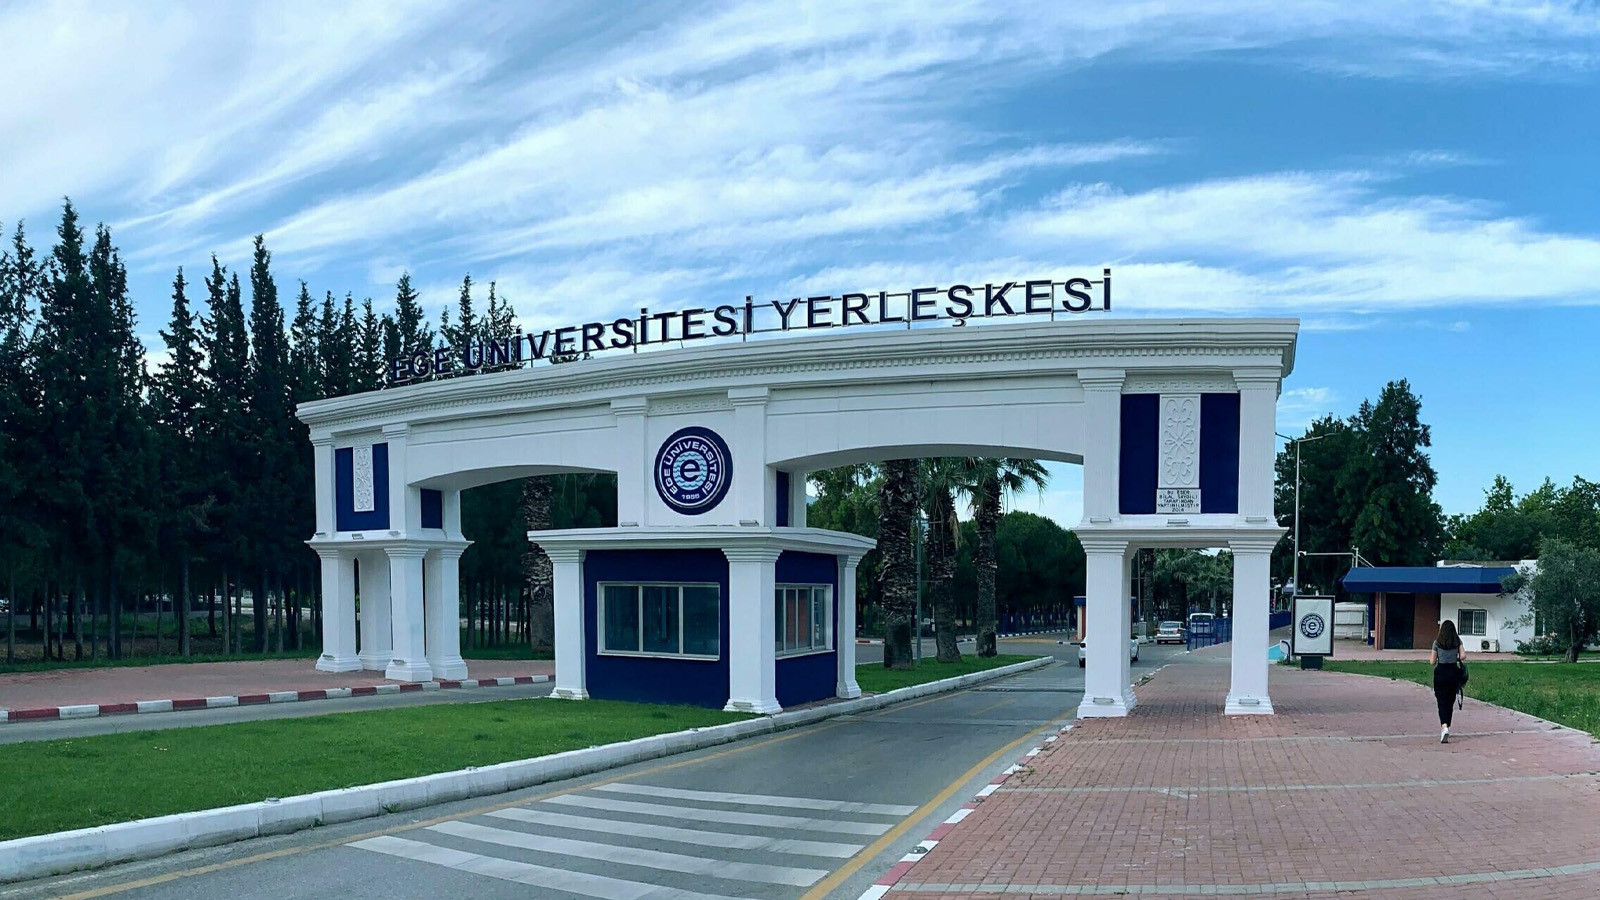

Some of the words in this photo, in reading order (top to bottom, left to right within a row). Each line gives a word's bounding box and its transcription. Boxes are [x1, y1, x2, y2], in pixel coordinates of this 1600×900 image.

[391, 346, 455, 383] EGE
[771, 268, 1112, 328] YERLEŞKESİ
[664, 441, 717, 495] ÜNİVERSİTESİ
[664, 469, 678, 495] EGE
[680, 459, 700, 482] e
